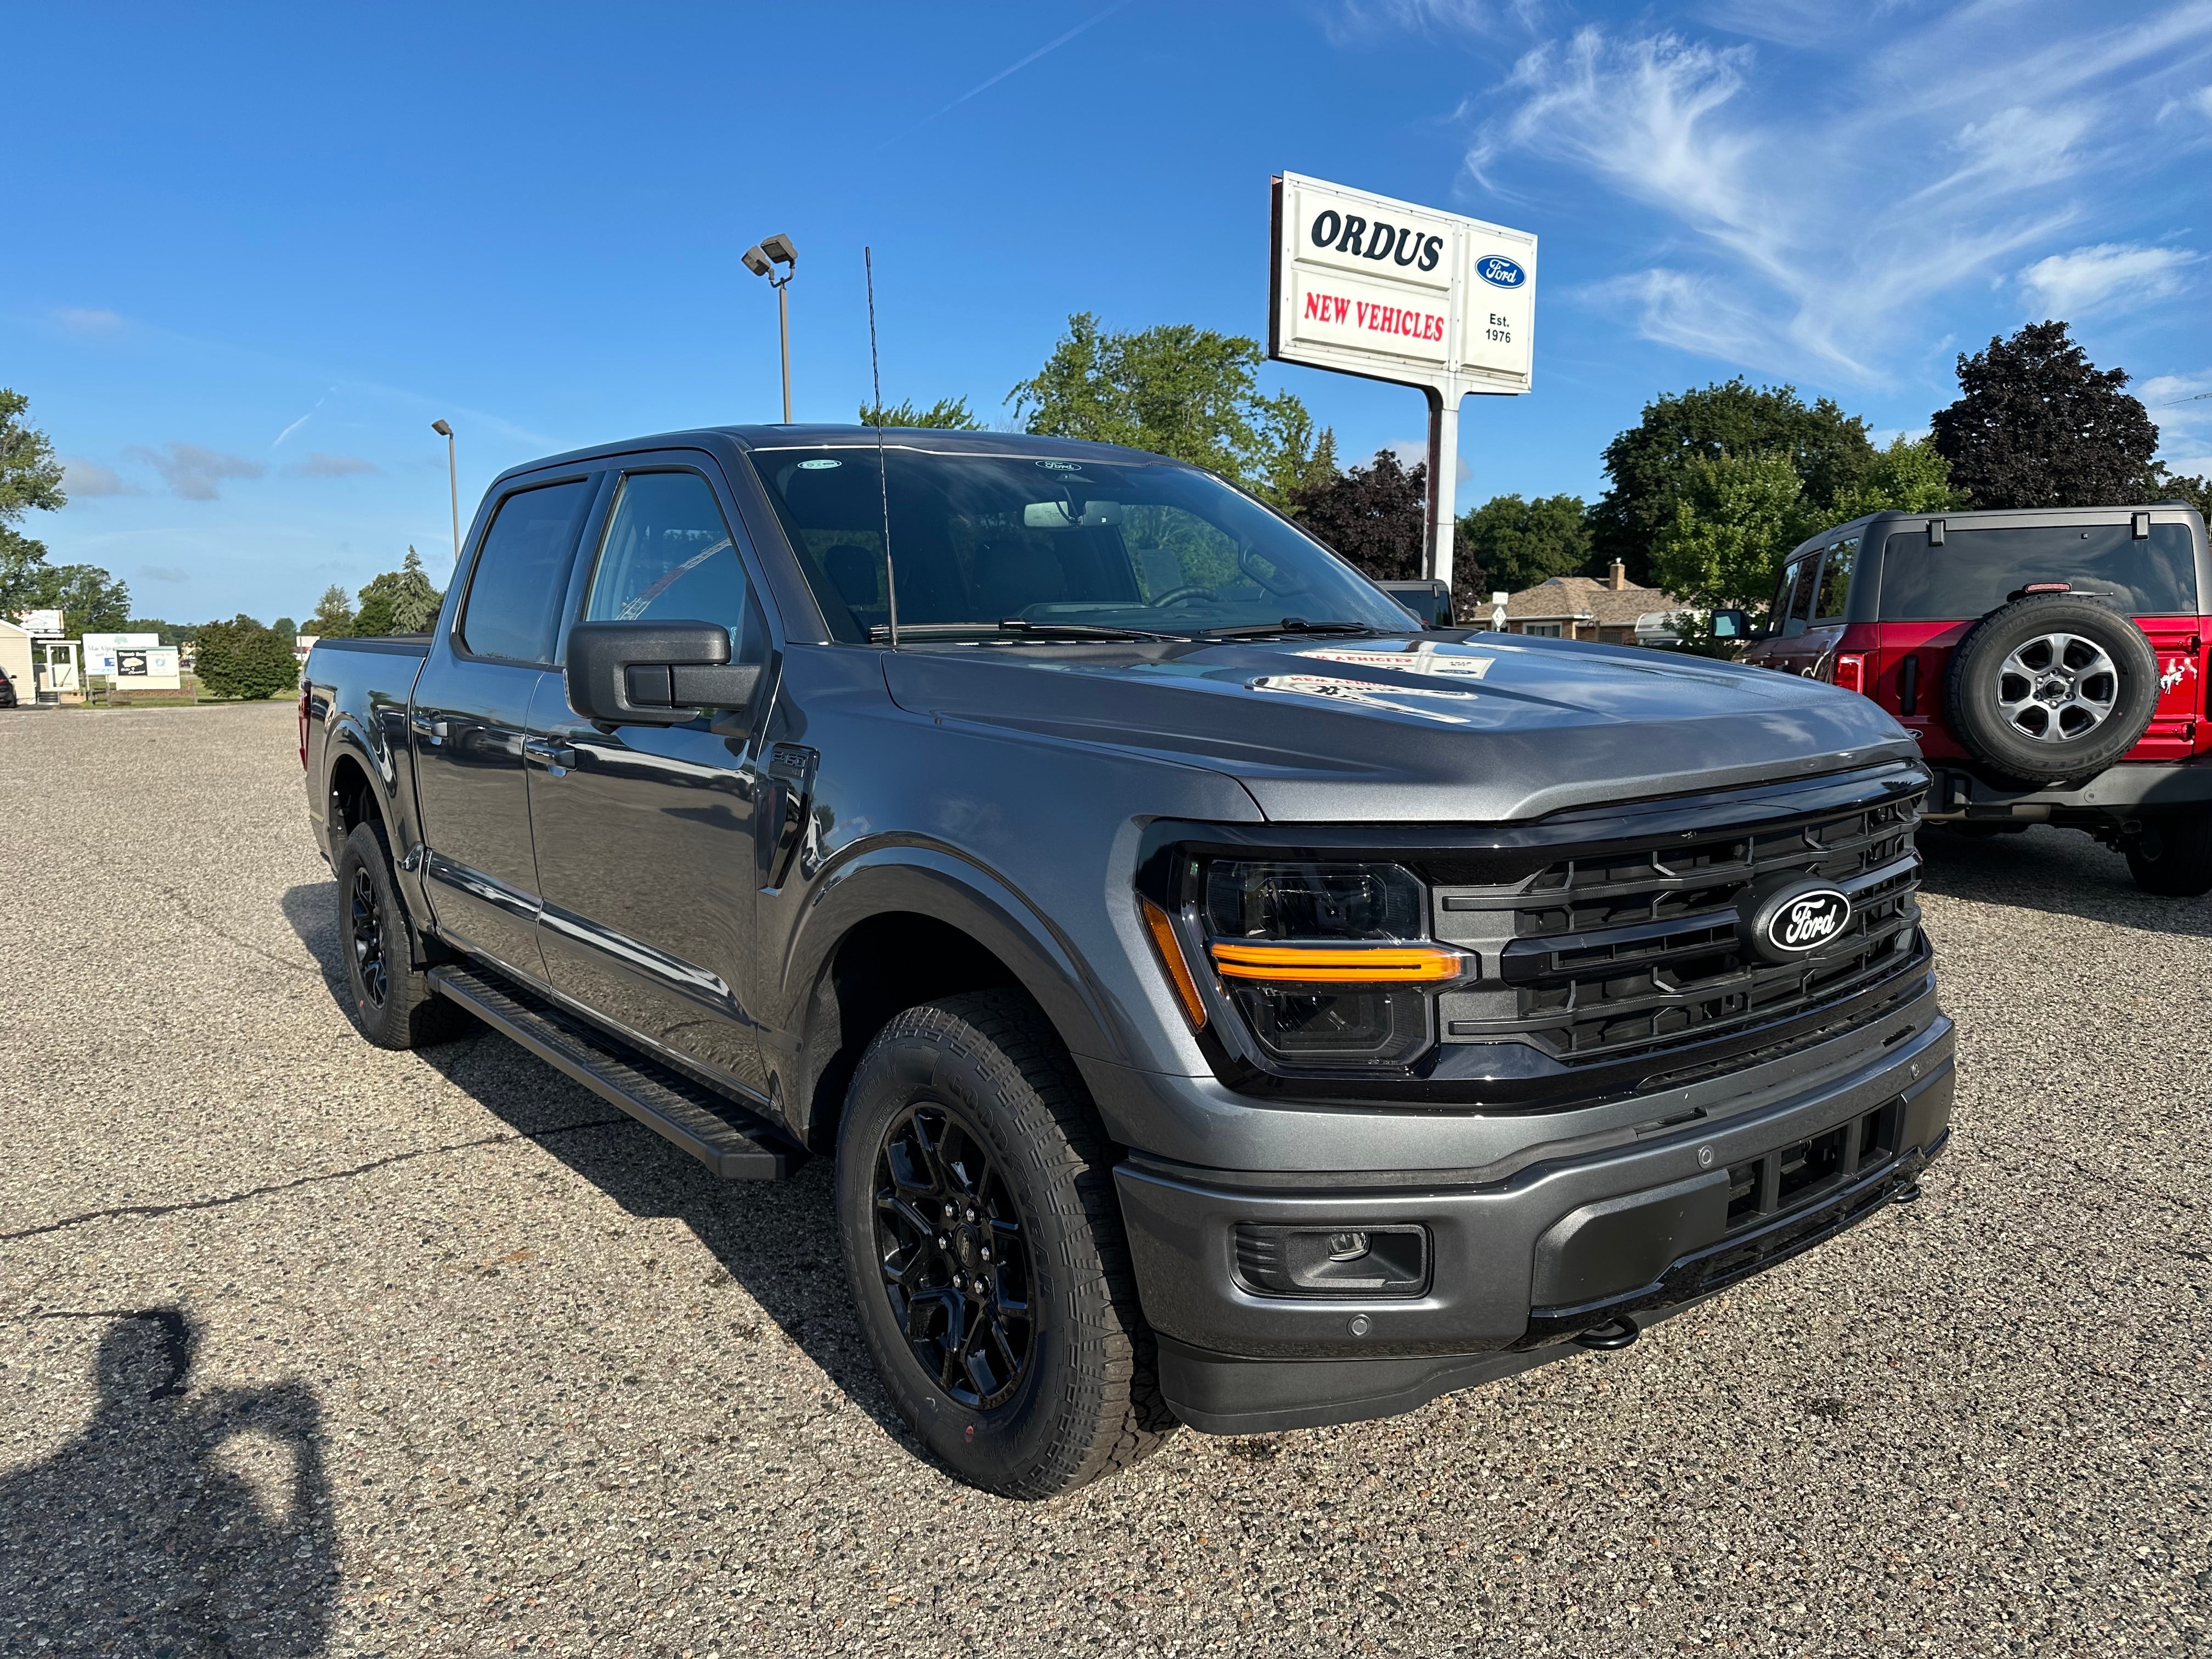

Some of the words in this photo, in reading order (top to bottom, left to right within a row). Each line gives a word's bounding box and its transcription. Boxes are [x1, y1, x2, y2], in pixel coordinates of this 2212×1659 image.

[1311, 210, 1443, 272] ORDUS
[1486, 259, 1517, 283] Ford
[1304, 292, 1351, 325] NEW
[1357, 301, 1444, 342] VEHICLES
[1489, 313, 1510, 328] Est.
[1486, 329, 1511, 343] 1976
[1045, 461, 1074, 470] Ford
[1496, 613, 1504, 622] 53
[1786, 899, 1837, 944] Ford
